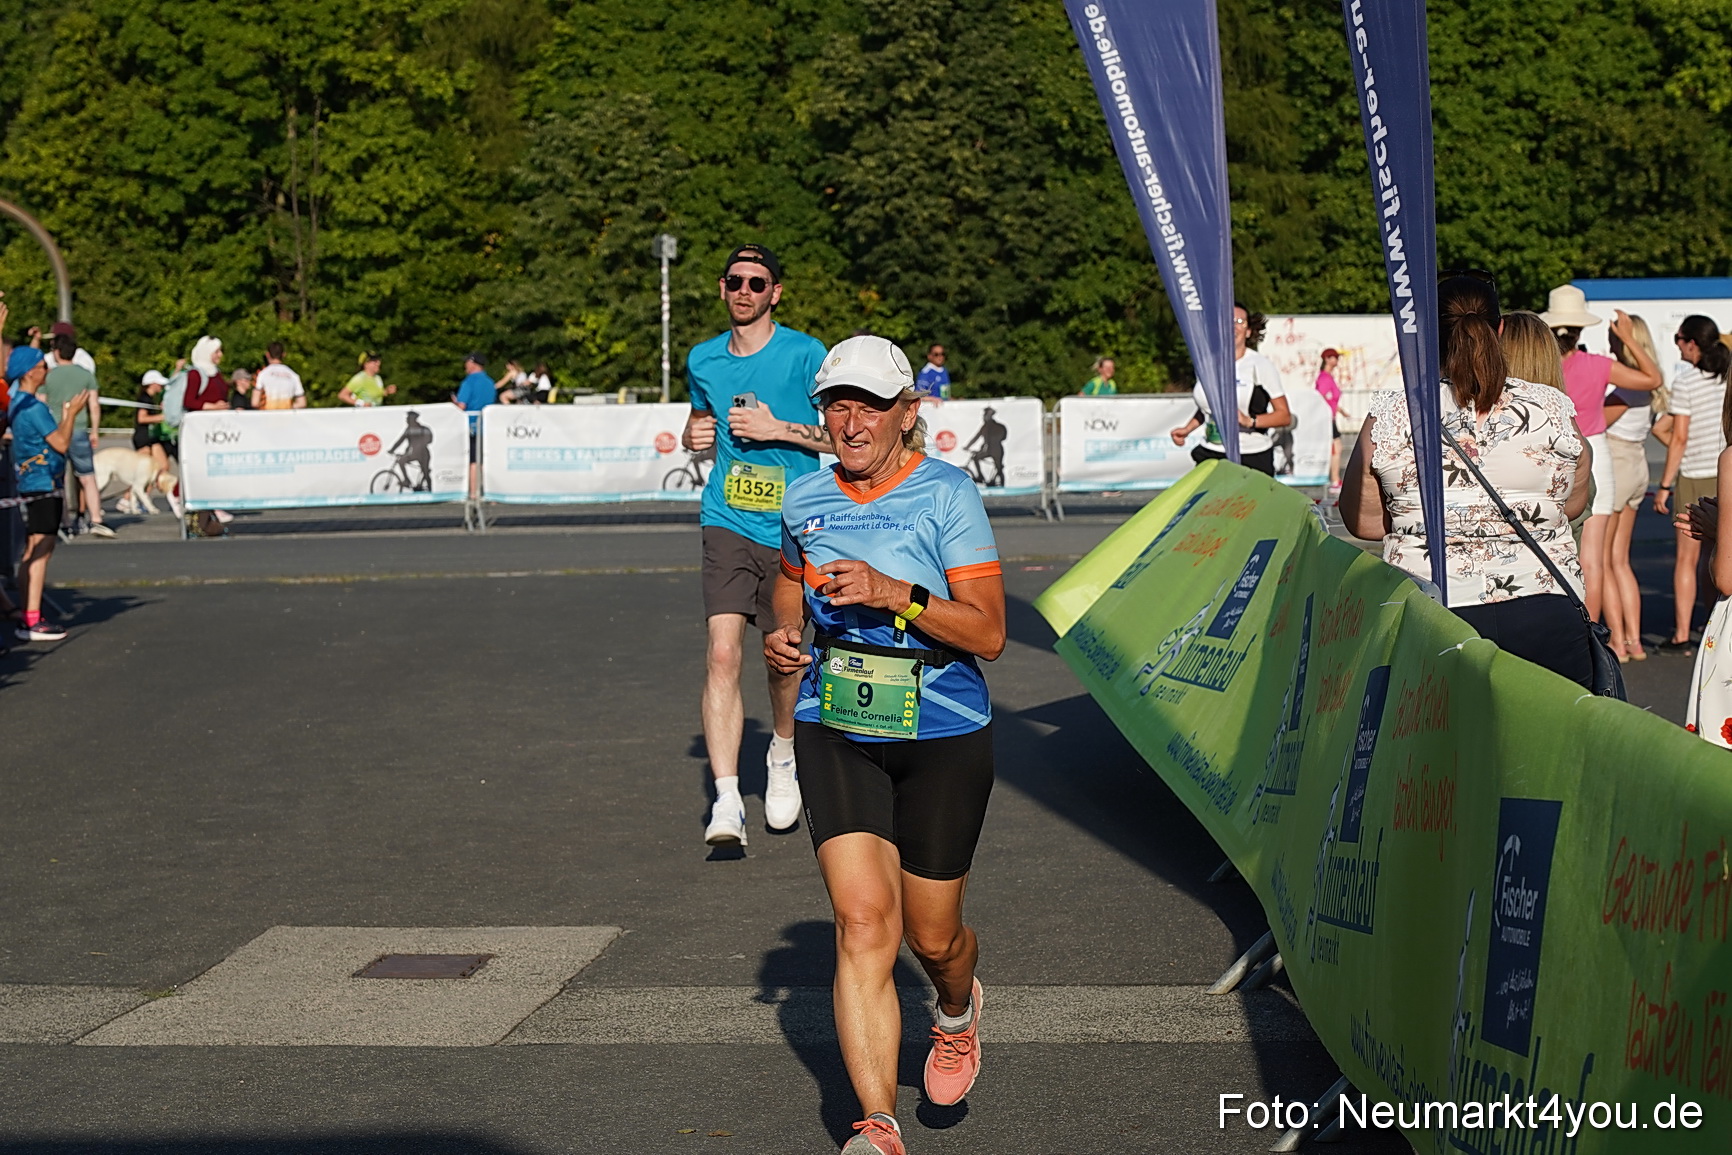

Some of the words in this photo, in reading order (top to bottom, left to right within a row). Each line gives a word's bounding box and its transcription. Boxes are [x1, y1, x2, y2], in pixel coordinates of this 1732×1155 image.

[734, 477, 775, 498] 1352
[828, 523, 870, 531] Neumarkt
[903, 523, 915, 532] eG
[829, 513, 892, 522] Raiffeisenbank
[823, 683, 833, 710] RUN
[857, 682, 874, 708] 9
[831, 704, 859, 717] Feierle
[860, 710, 903, 723] Cornelia
[902, 690, 915, 727] 2022
[1602, 820, 1694, 935] Gesunde
[1500, 875, 1539, 921] Fischer
[1501, 925, 1531, 947] AUTOMOBILE
[1625, 960, 1694, 1088] laufen
